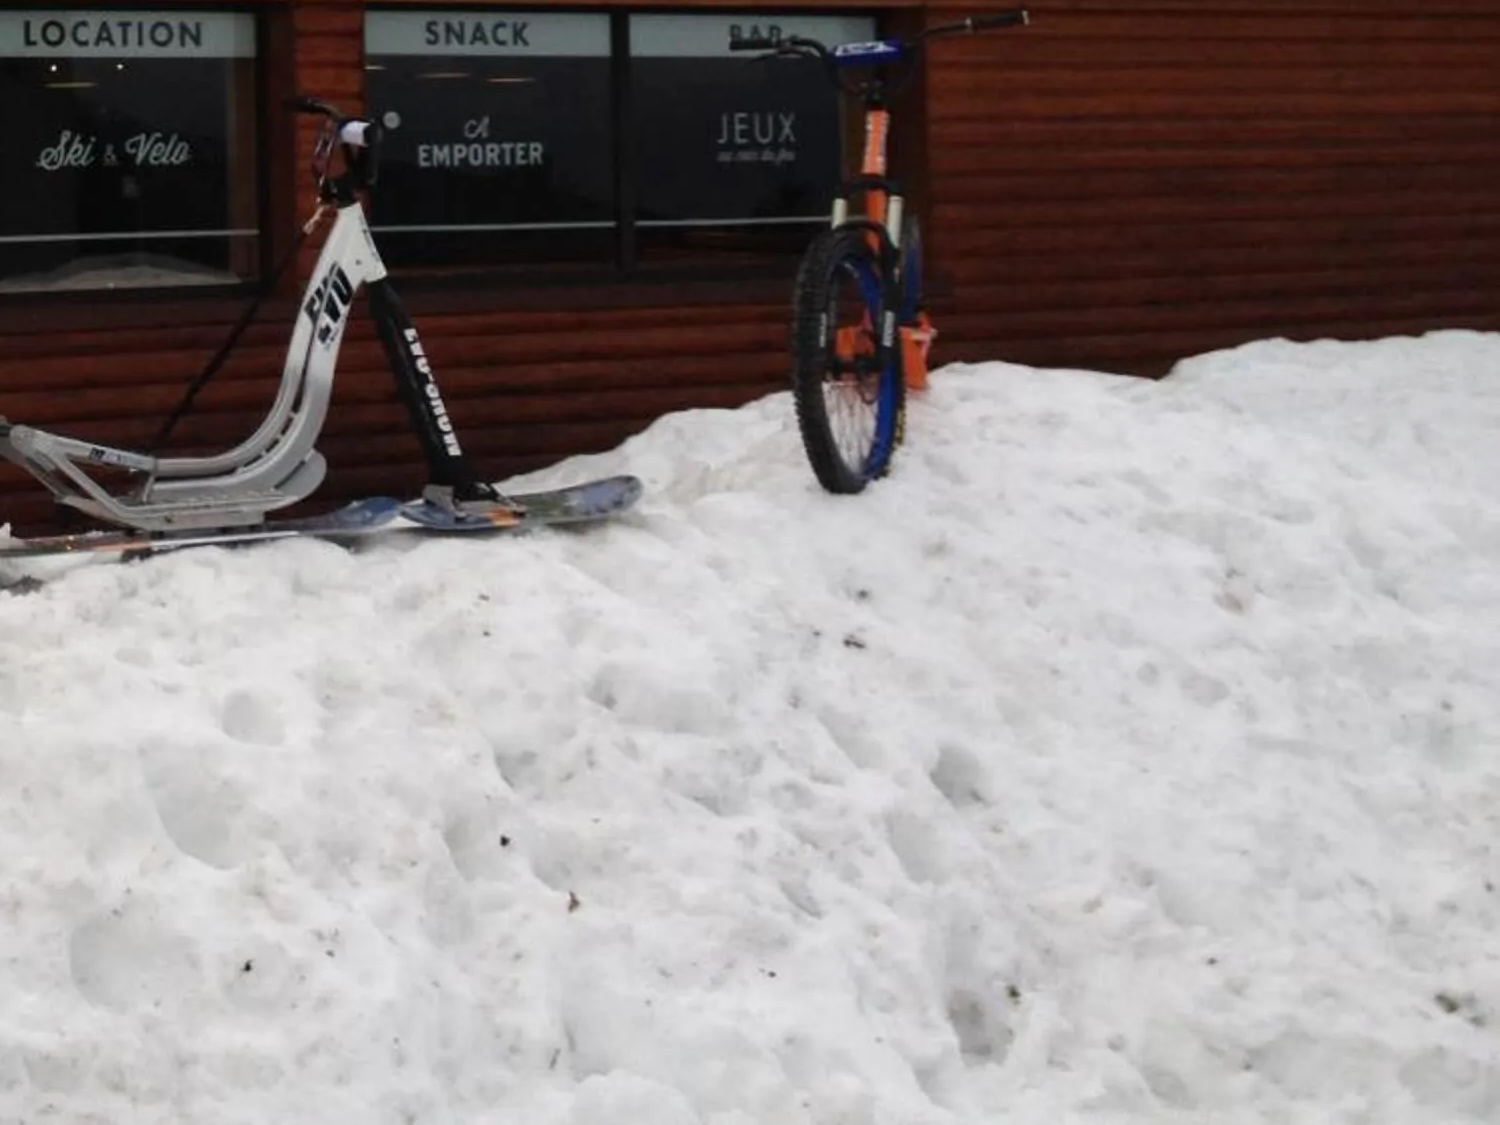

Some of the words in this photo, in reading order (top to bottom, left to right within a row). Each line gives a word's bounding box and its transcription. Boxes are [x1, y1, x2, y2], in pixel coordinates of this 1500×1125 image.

[22, 18, 204, 49] LOCATION
[424, 19, 531, 48] SNACK
[715, 111, 797, 146] JEUX
[35, 128, 97, 172] Ski
[416, 140, 545, 168] EMPORTER
